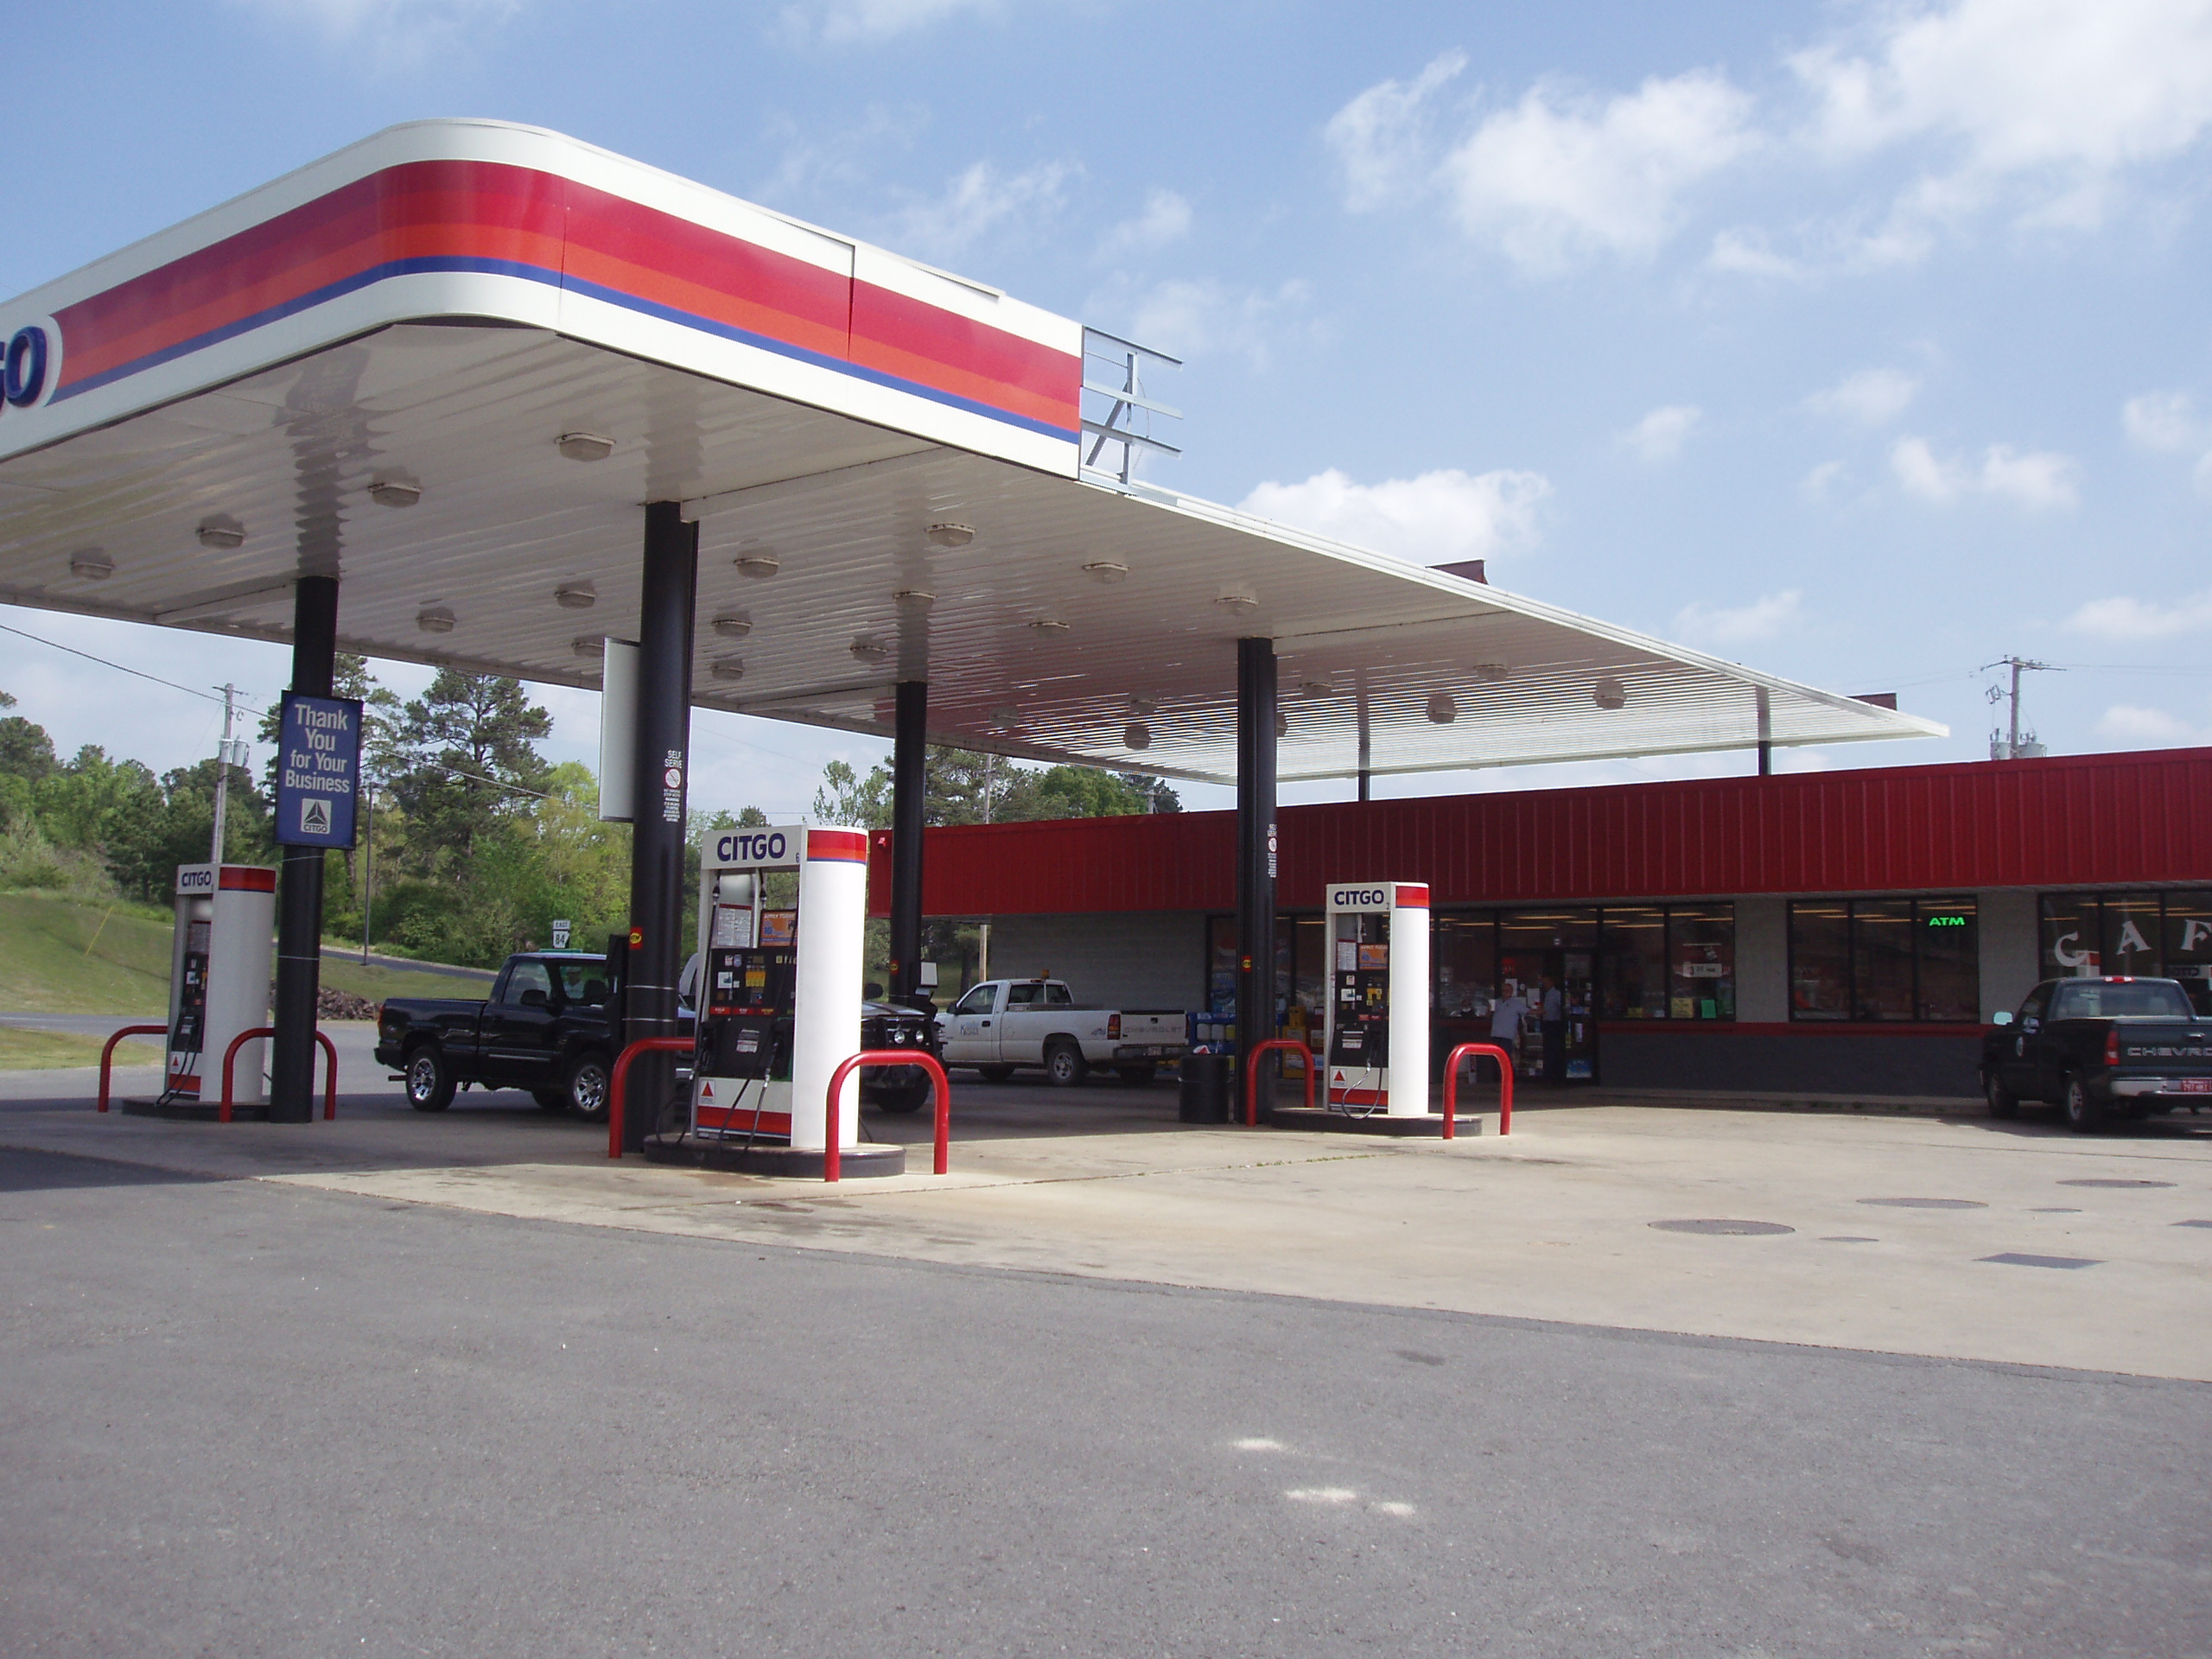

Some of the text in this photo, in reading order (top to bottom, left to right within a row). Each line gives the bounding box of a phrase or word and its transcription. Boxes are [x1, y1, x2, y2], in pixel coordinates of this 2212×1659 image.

[0, 326, 47, 413] O
[295, 703, 348, 731] Thank
[304, 728, 335, 752] You
[290, 749, 347, 773] for Your
[285, 769, 350, 794] Business
[303, 823, 328, 834] CITGO
[716, 832, 786, 862] CITGO
[181, 871, 212, 887] CITGO
[1334, 889, 1384, 906] CITGO
[1929, 917, 1966, 926] ATM
